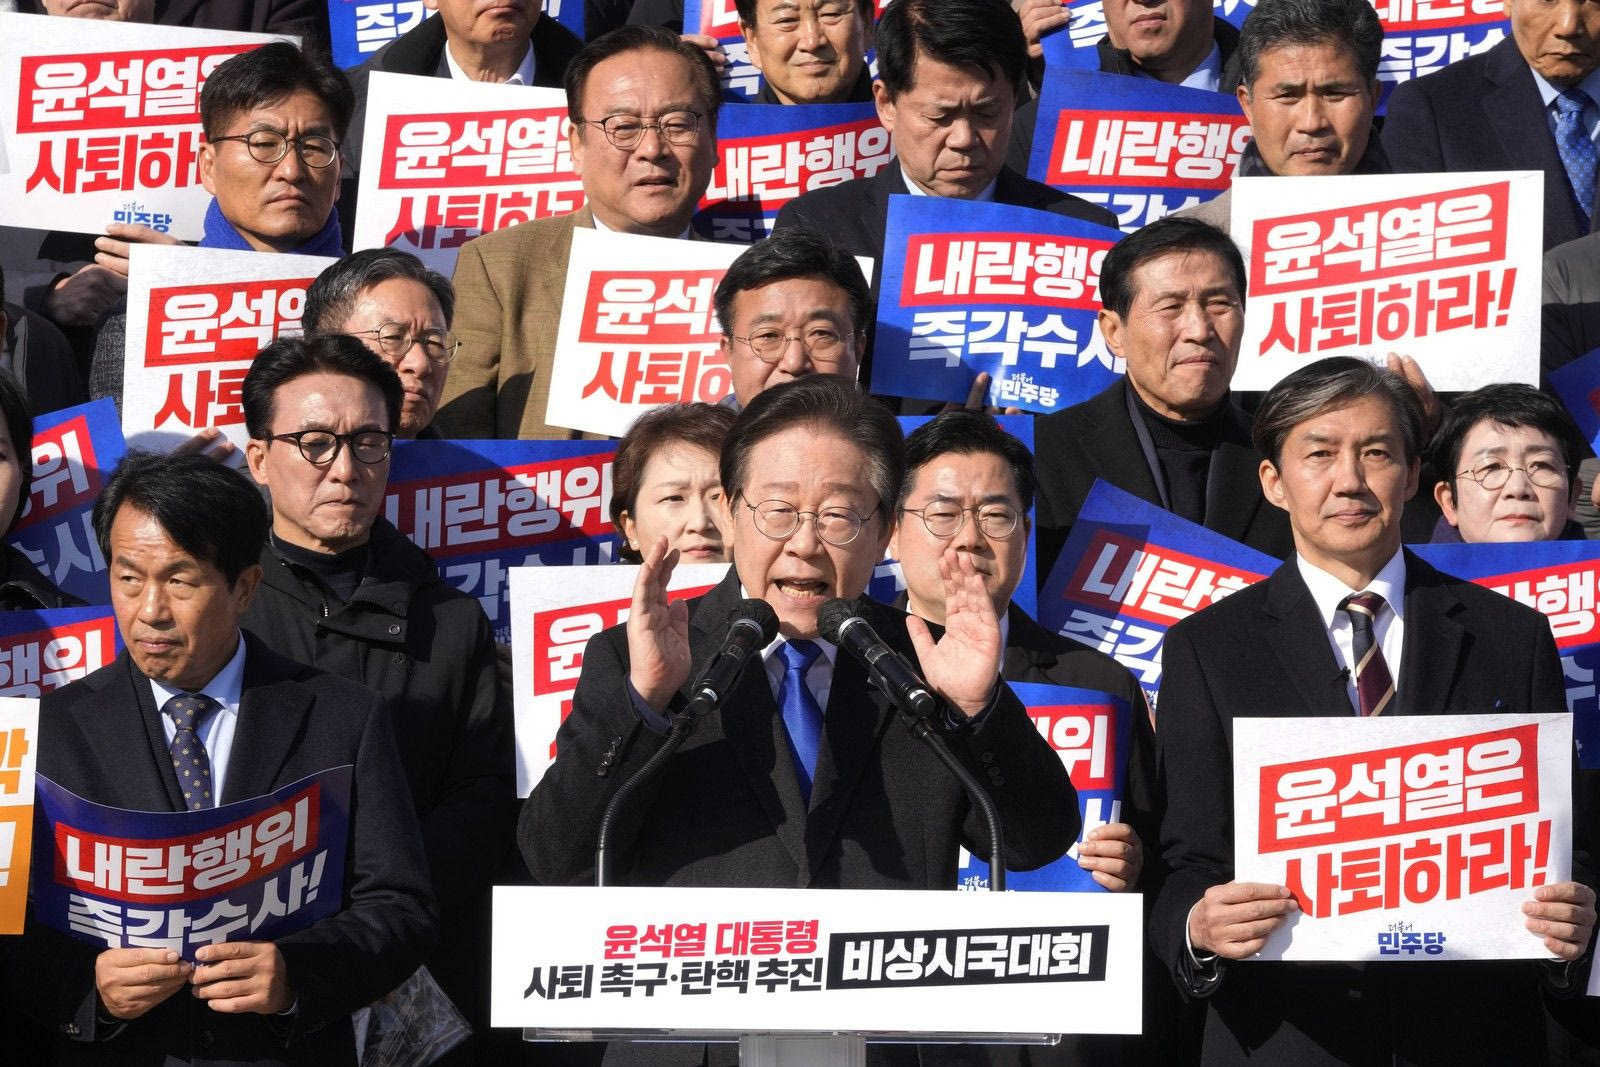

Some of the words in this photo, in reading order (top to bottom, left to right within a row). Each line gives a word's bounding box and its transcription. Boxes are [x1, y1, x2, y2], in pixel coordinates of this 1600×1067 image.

[32, 55, 221, 123] 윤석열
[26, 131, 203, 195] 사퇴하
[1263, 193, 1493, 285] 윤석열은
[595, 278, 724, 335] 윤석
[1259, 267, 1518, 357] 사퇴하라!
[1001, 379, 1060, 408] 민주당
[1275, 737, 1524, 841] 윤석열은
[66, 796, 309, 896] 내란행위
[1284, 819, 1552, 919] 사퇴하라!
[67, 849, 328, 957] 즉각수사!
[604, 923, 707, 960] 윤석열
[715, 919, 819, 956] 대통령
[842, 932, 1093, 982] 비상시국대회
[1377, 931, 1447, 956] 민주당
[523, 964, 594, 1000] 사퇴
[755, 957, 823, 993] 추진
